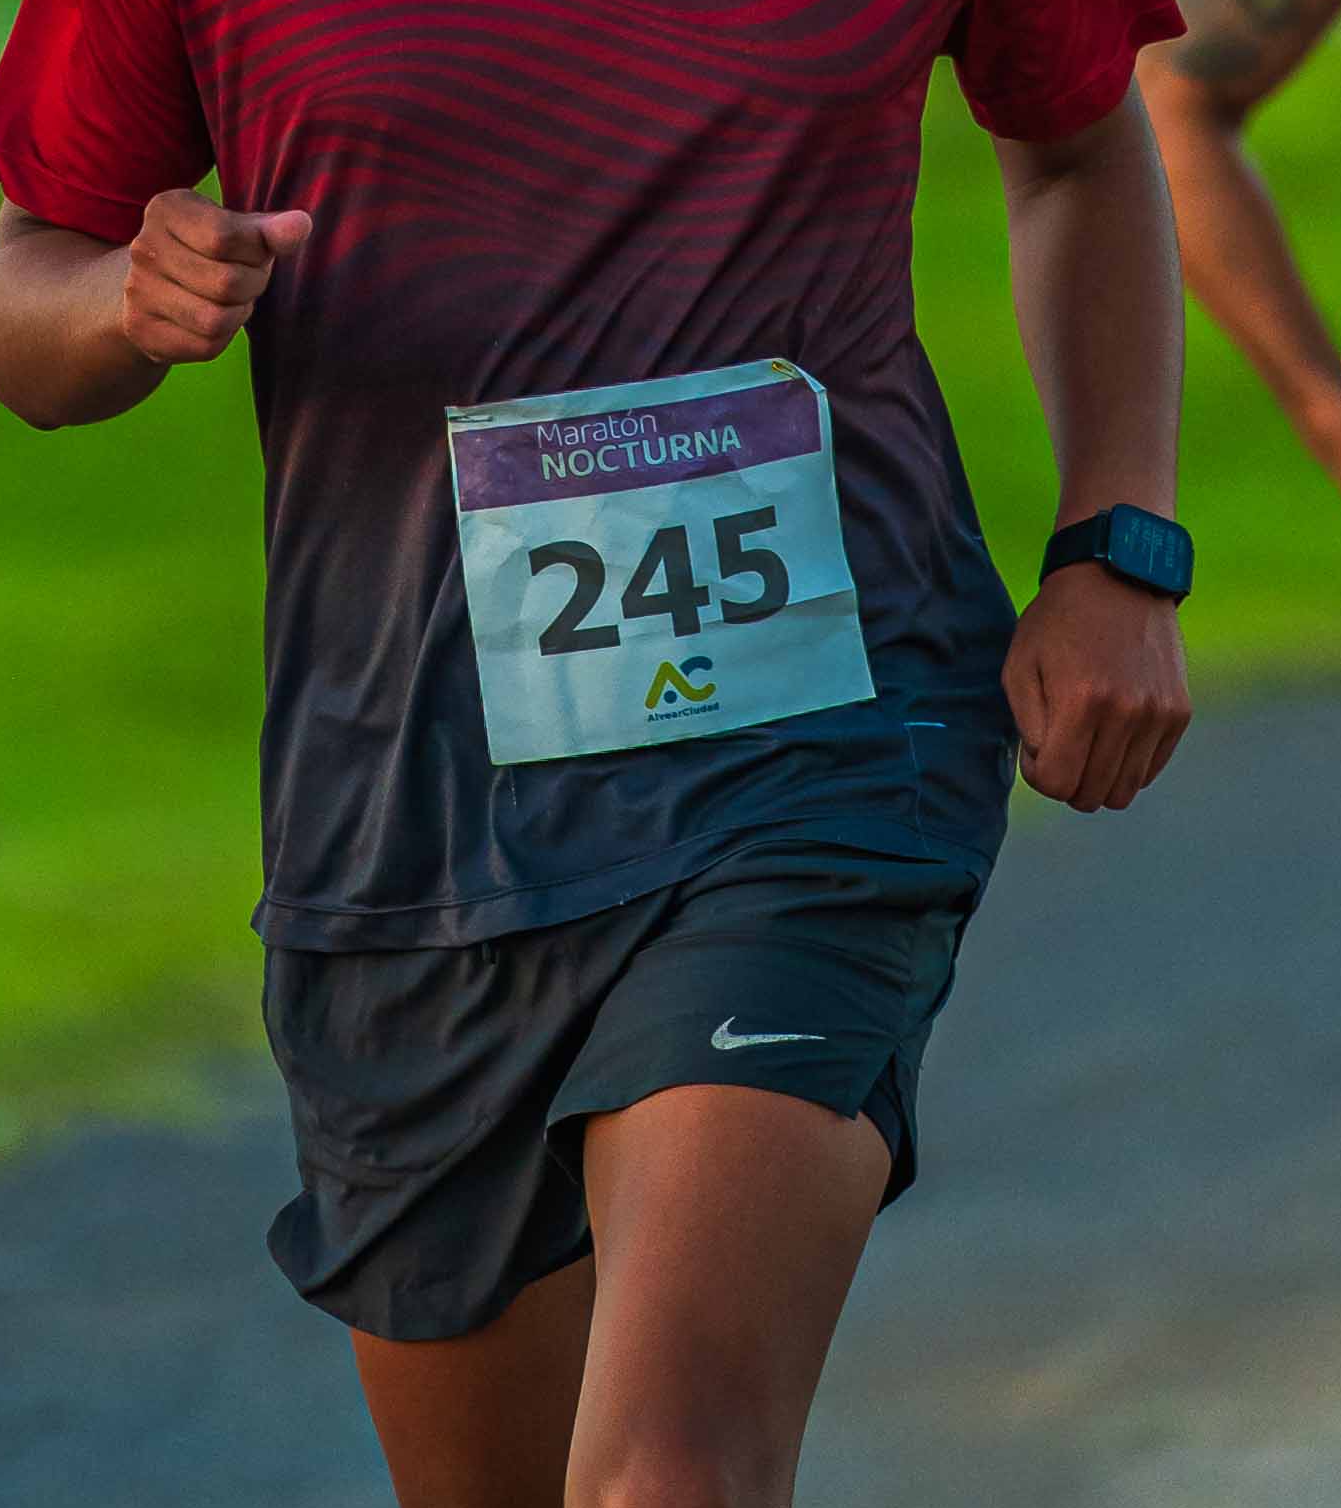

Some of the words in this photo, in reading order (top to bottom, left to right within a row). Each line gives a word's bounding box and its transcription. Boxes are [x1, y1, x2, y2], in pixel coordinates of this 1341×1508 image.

[538, 409, 658, 449] Maratón
[541, 425, 742, 481] NOCTURNA
[528, 505, 790, 657] 245
